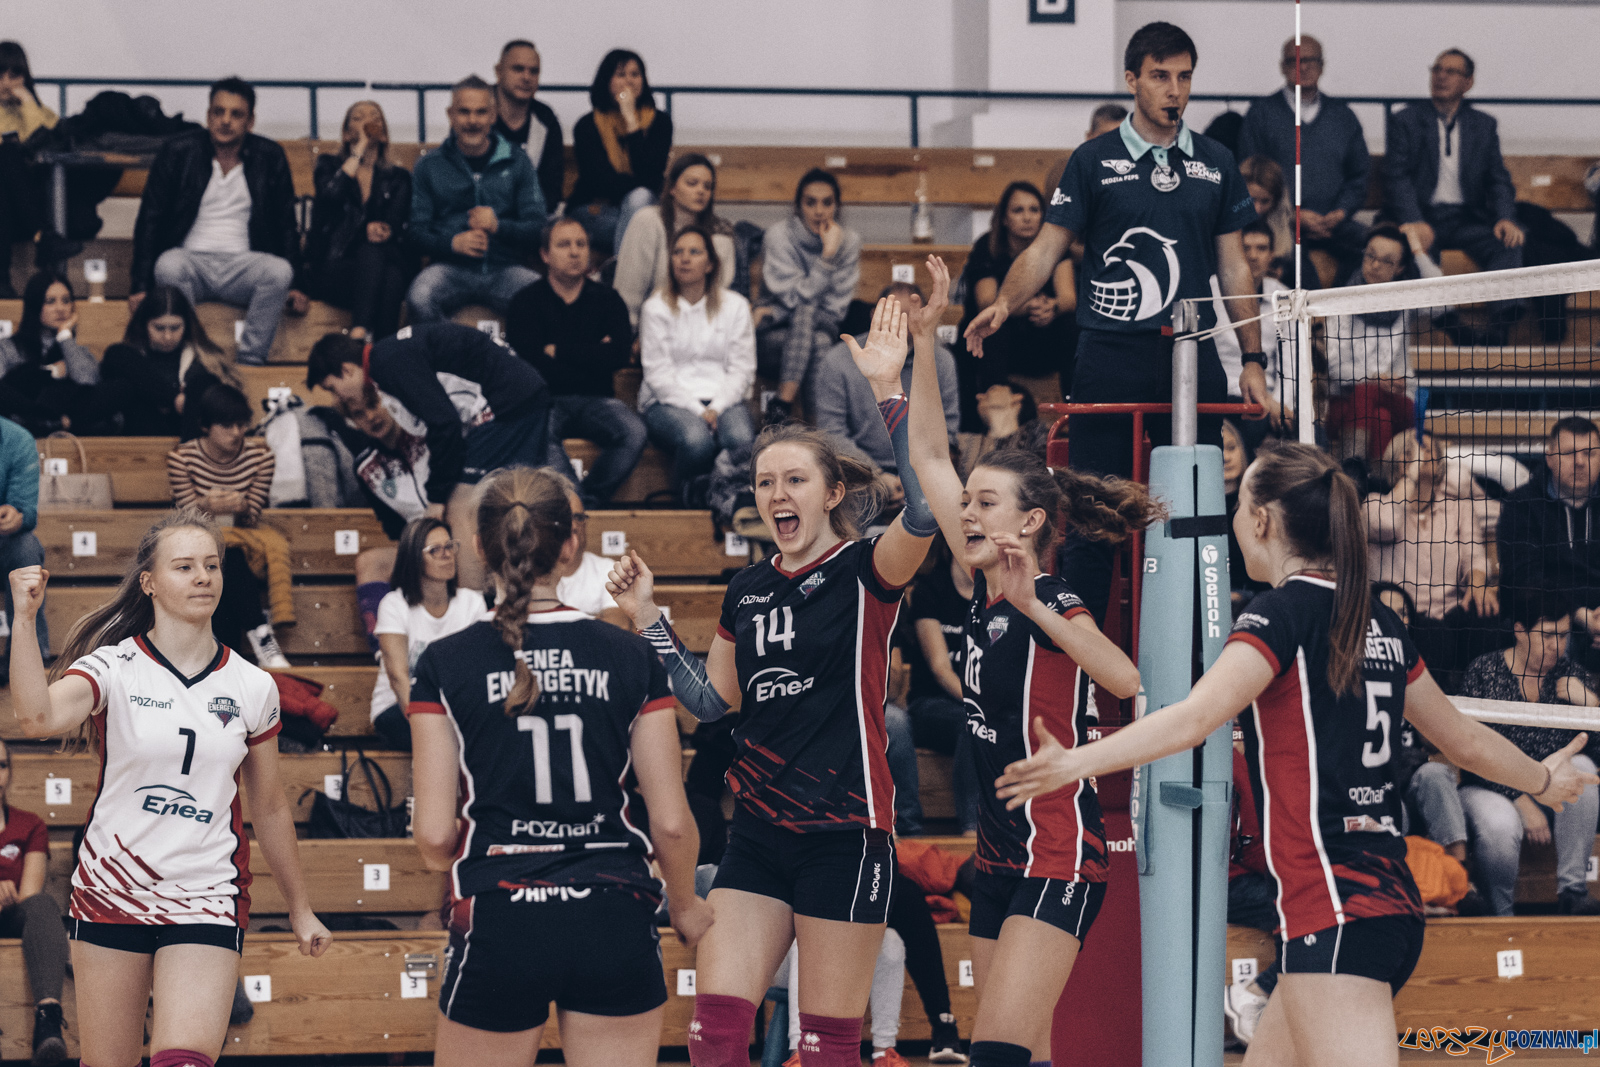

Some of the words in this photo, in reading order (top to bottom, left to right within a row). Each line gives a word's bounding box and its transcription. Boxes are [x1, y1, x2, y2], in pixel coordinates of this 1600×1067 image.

[81, 535, 90, 547] 4
[1205, 567, 1220, 638] Senoh
[752, 605, 796, 657] 14
[486, 668, 610, 704] ENRGETYK
[756, 676, 815, 702] Enea
[967, 718, 997, 744] nea
[1361, 680, 1393, 769] 5
[54, 783, 63, 795] 5
[141, 794, 214, 824] Enea
[1106, 836, 1137, 853] noh
[373, 869, 382, 881] 3
[1238, 963, 1252, 977] 13
[1503, 955, 1517, 968] 11
[254, 980, 264, 993] 4
[410, 975, 419, 988] 3
